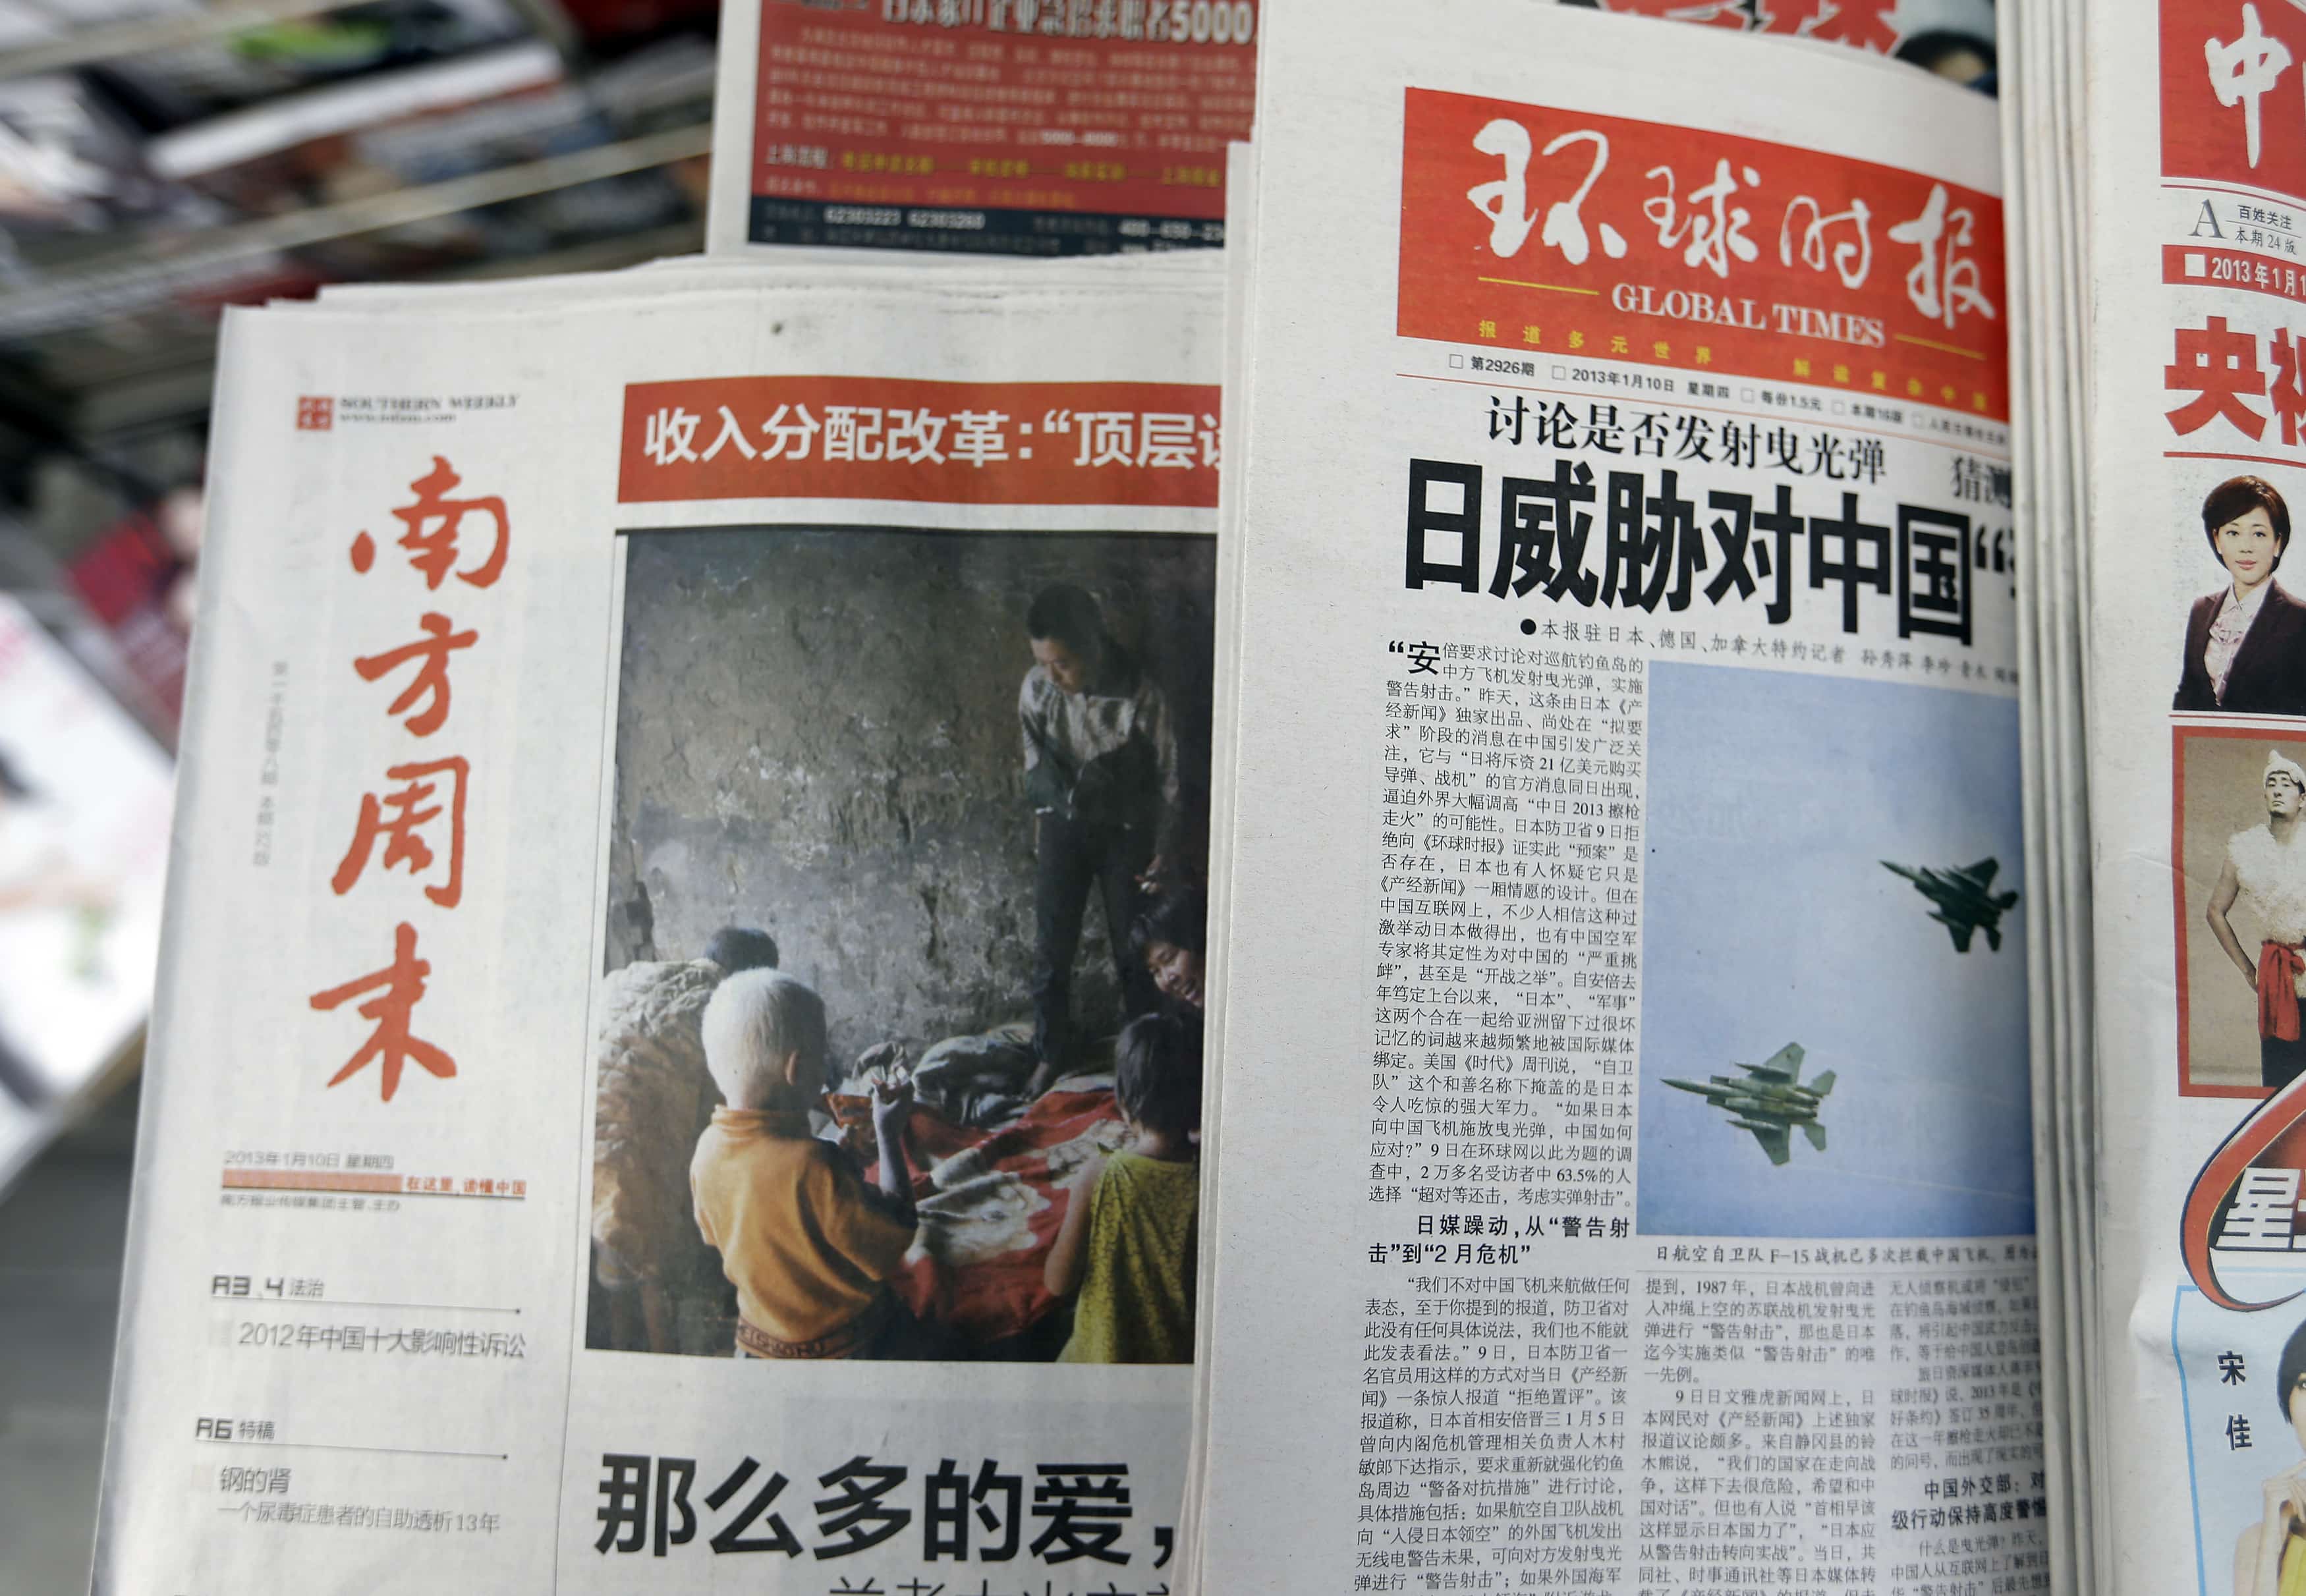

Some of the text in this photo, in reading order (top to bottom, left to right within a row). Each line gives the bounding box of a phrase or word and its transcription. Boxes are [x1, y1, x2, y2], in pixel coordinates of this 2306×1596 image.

[1467, 118, 1996, 329] 环球时报
[2187, 199, 2228, 239] A
[2238, 204, 2292, 230] 百姓关注
[2235, 227, 2297, 255] 本期24版
[1612, 282, 1886, 348] GLOBAL TIMES
[1478, 319, 1712, 365] 报道多元世界
[1471, 356, 1534, 377] 第2926期
[1571, 368, 1674, 393] 2013年1月10日
[1687, 381, 1730, 399] 星期四
[1761, 389, 1822, 412] 每份1.5元
[1488, 395, 1886, 485] 讨论是否发射曳光弹
[1405, 458, 2015, 647] 日威胁对中国“
[1443, 642, 1643, 673] 倍要求讨论对巡航钓鱼岛的
[1541, 618, 1846, 666] 本报驻日本、德国、加拿大特约记者
[1443, 664, 1643, 694] 中方飞机发射曳光弹，实施
[310, 454, 511, 1102] 南方周末
[345, 1153, 394, 1170] 星期四
[289, 1277, 325, 1298] 法治
[238, 1321, 526, 1360] 2012年中国十大影响性诉讼
[1644, 1366, 1699, 1384] 一先例。
[196, 1417, 275, 1440] A6 特稿
[220, 1465, 292, 1494] 钢的肾
